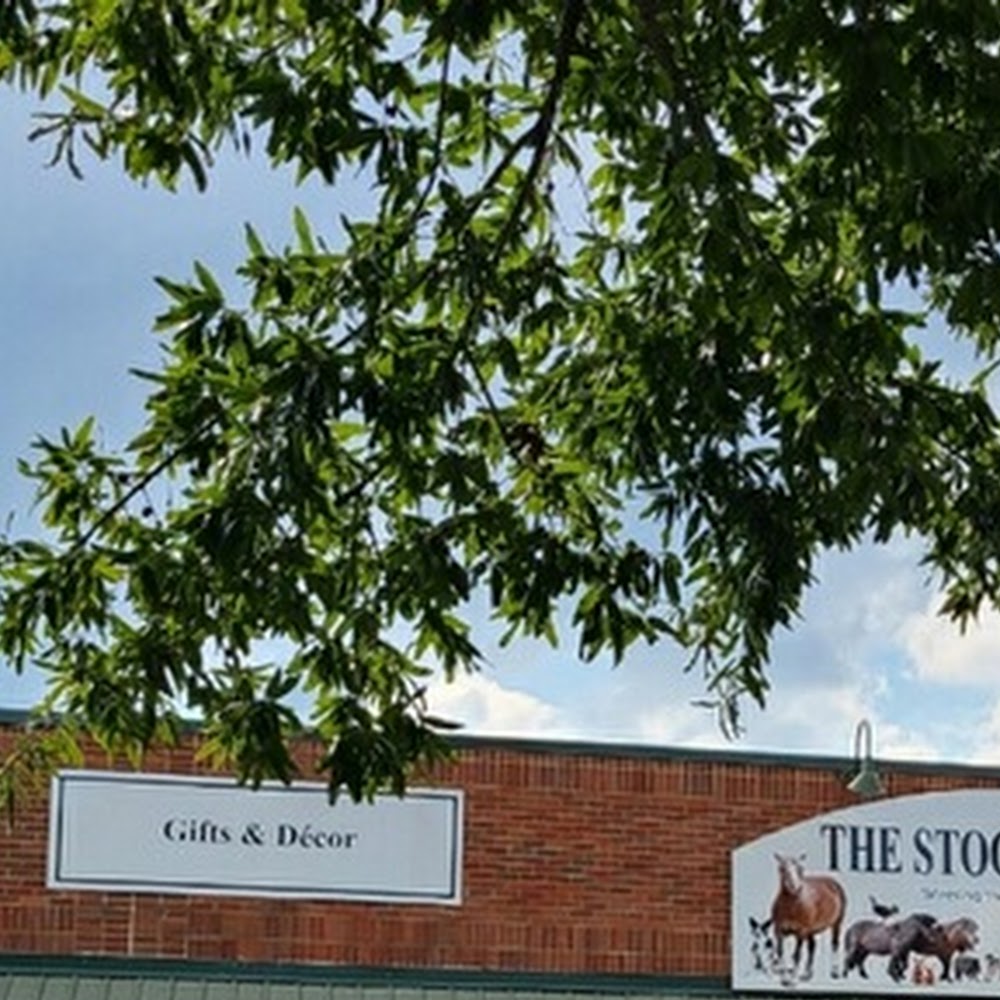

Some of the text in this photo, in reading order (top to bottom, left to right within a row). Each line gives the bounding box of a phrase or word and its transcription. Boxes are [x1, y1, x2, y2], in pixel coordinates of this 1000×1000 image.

[163, 819, 359, 849] Gifts & Décor
[820, 824, 902, 873] THE
